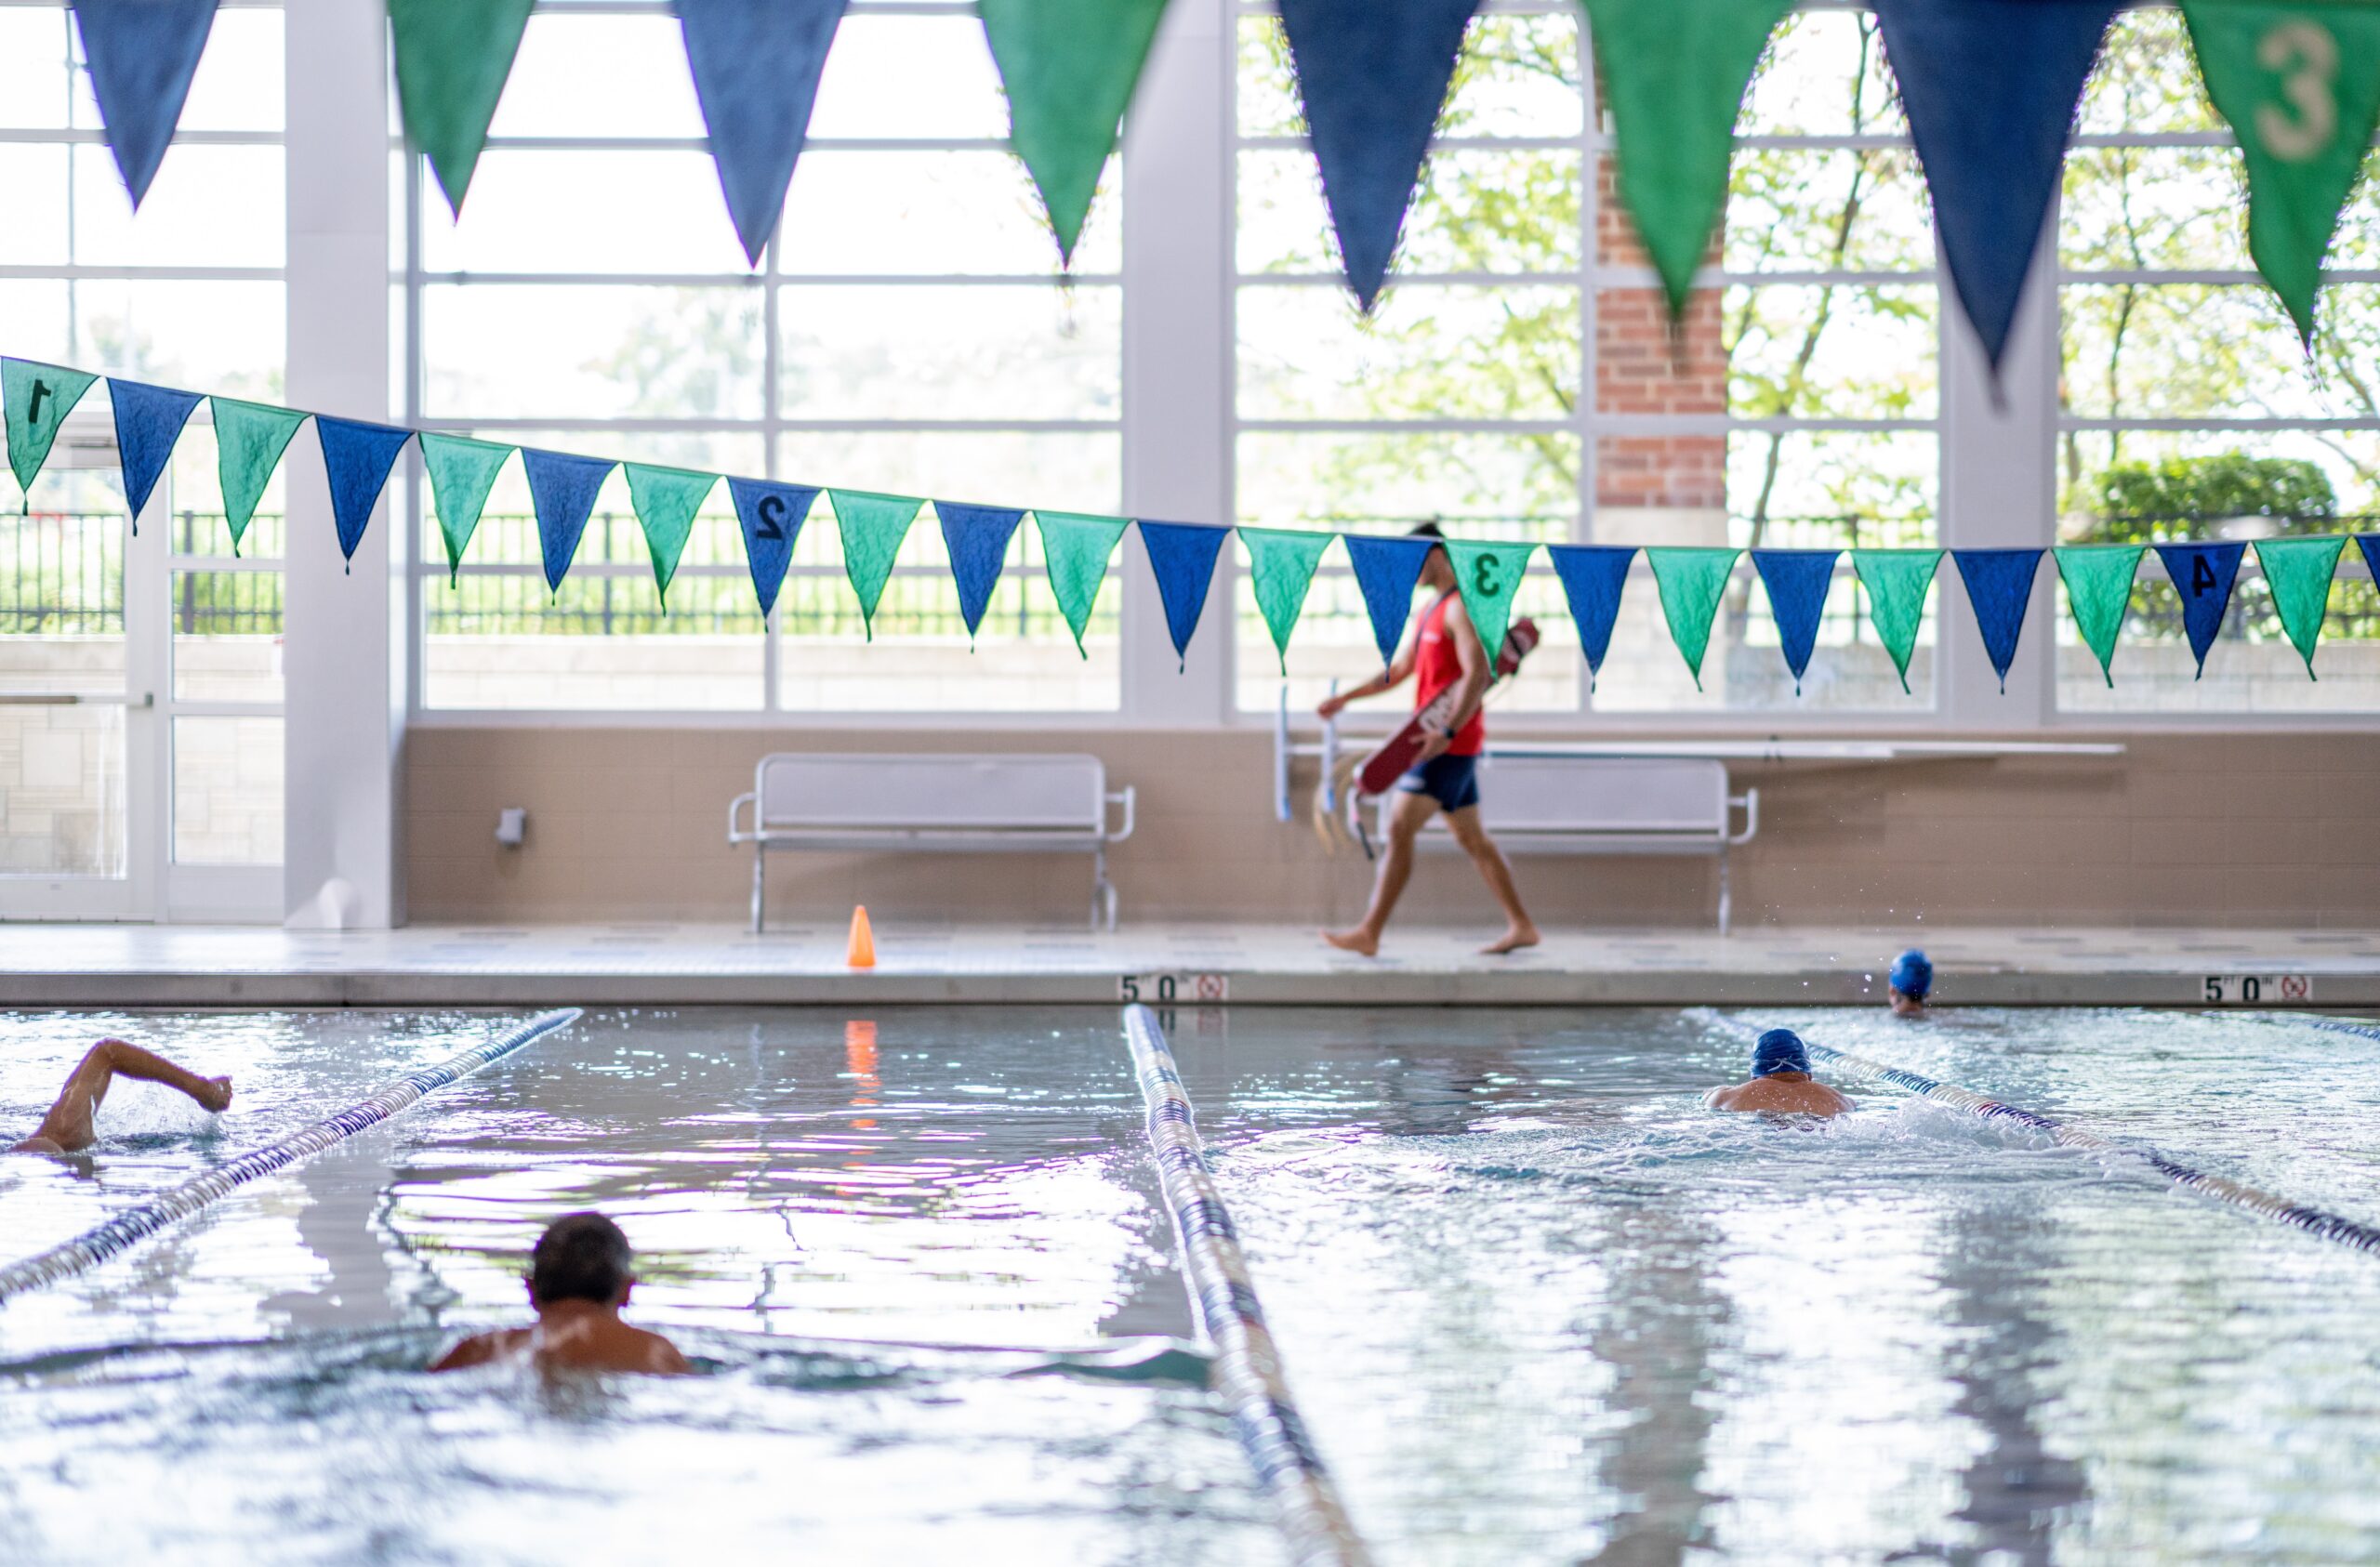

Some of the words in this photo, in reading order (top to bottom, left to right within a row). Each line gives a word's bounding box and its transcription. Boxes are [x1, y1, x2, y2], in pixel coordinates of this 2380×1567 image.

[2254, 19, 2338, 159] 3
[1122, 975, 1139, 1002] 5
[1159, 975, 1175, 1001] 0
[2206, 977, 2223, 1001] 5
[2242, 977, 2260, 1001] 0
